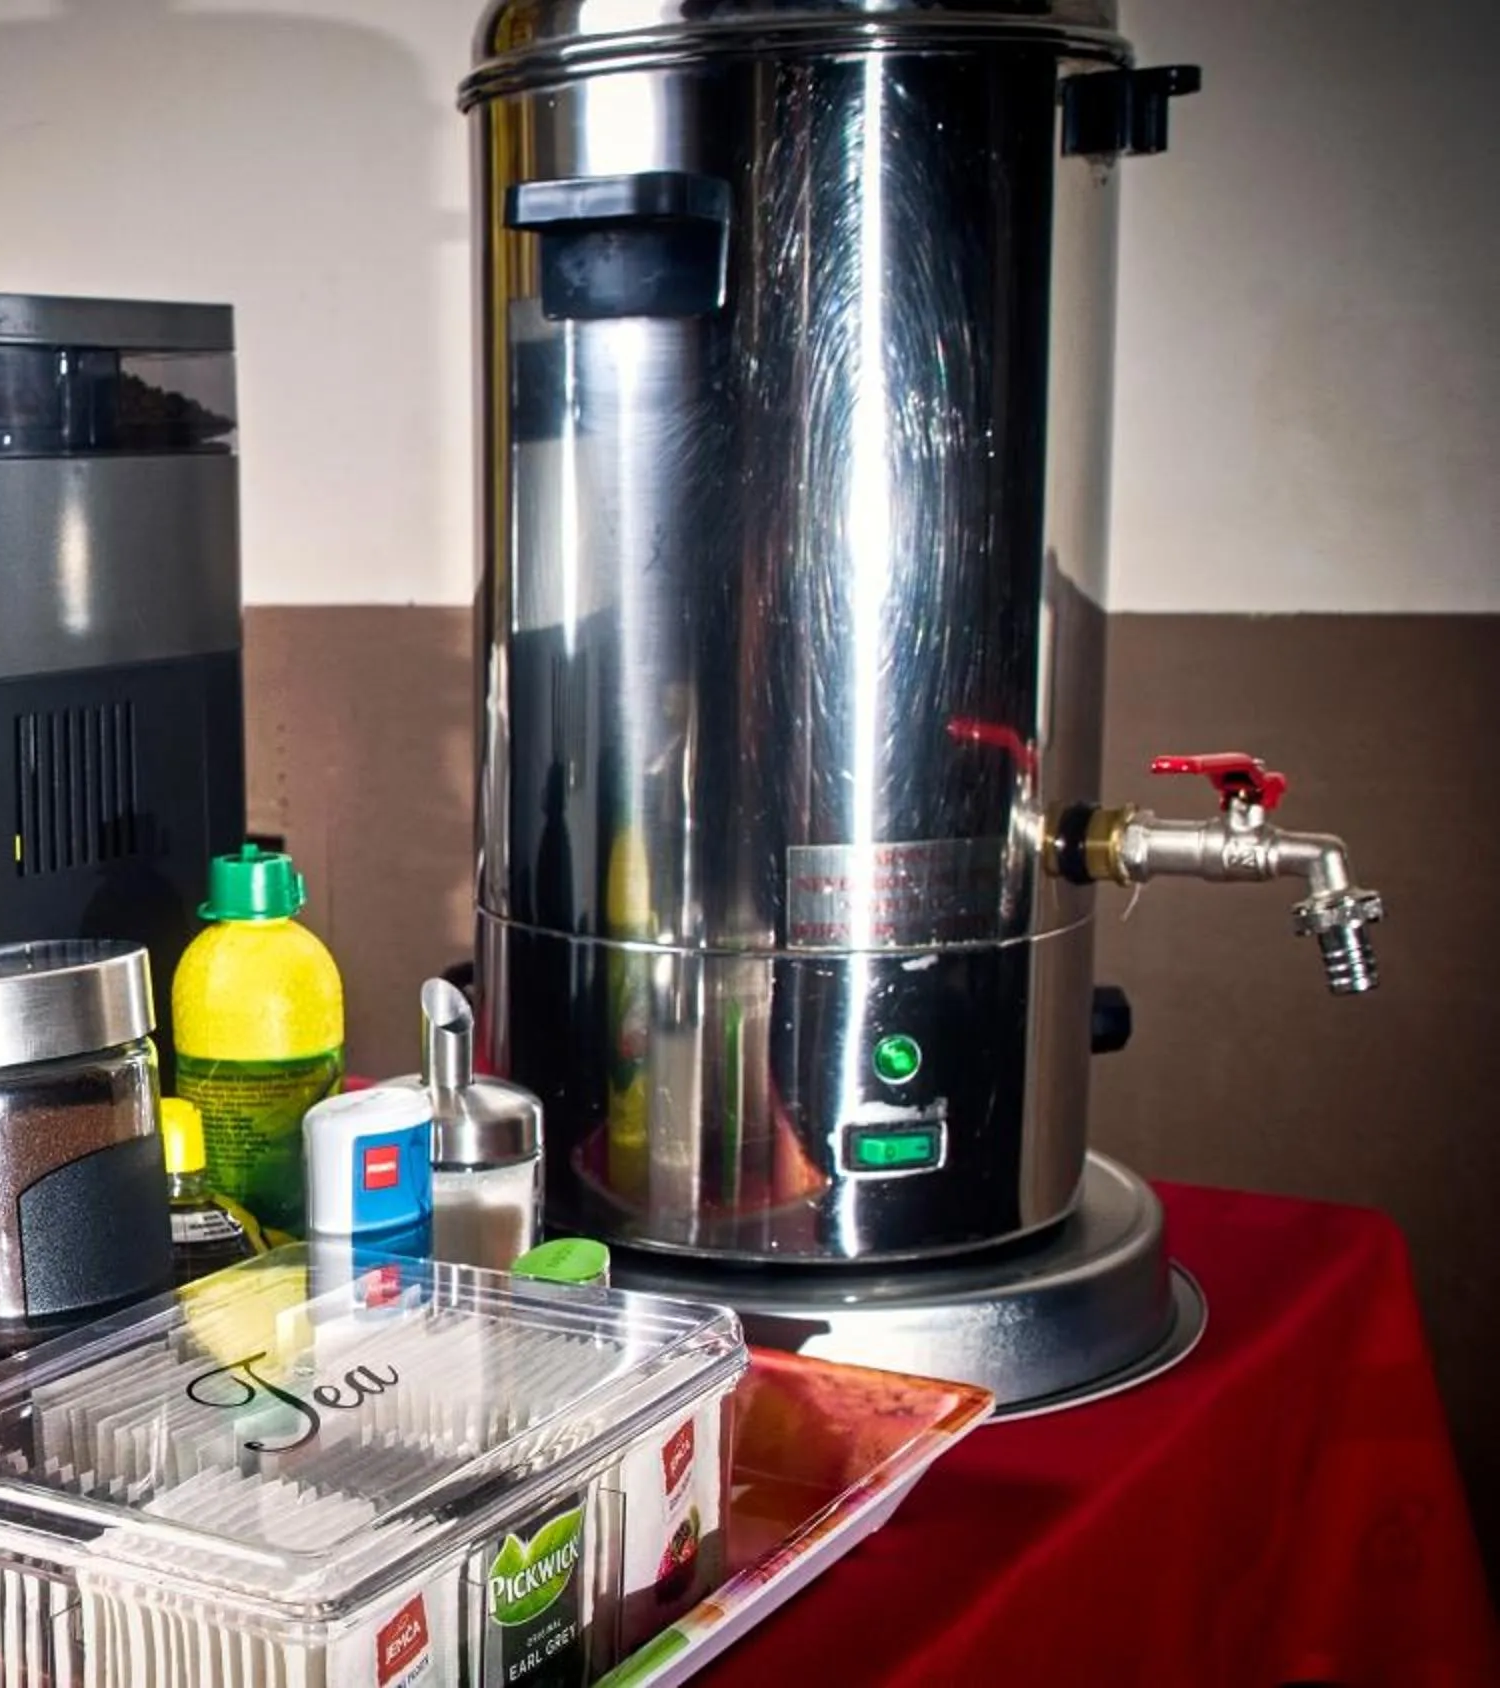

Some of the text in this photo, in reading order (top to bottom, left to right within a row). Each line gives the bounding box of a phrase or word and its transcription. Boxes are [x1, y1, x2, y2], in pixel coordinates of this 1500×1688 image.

[185, 1351, 399, 1454] Tea
[489, 1535, 579, 1615] PICKWICK
[509, 1622, 577, 1682] EARL GREY
